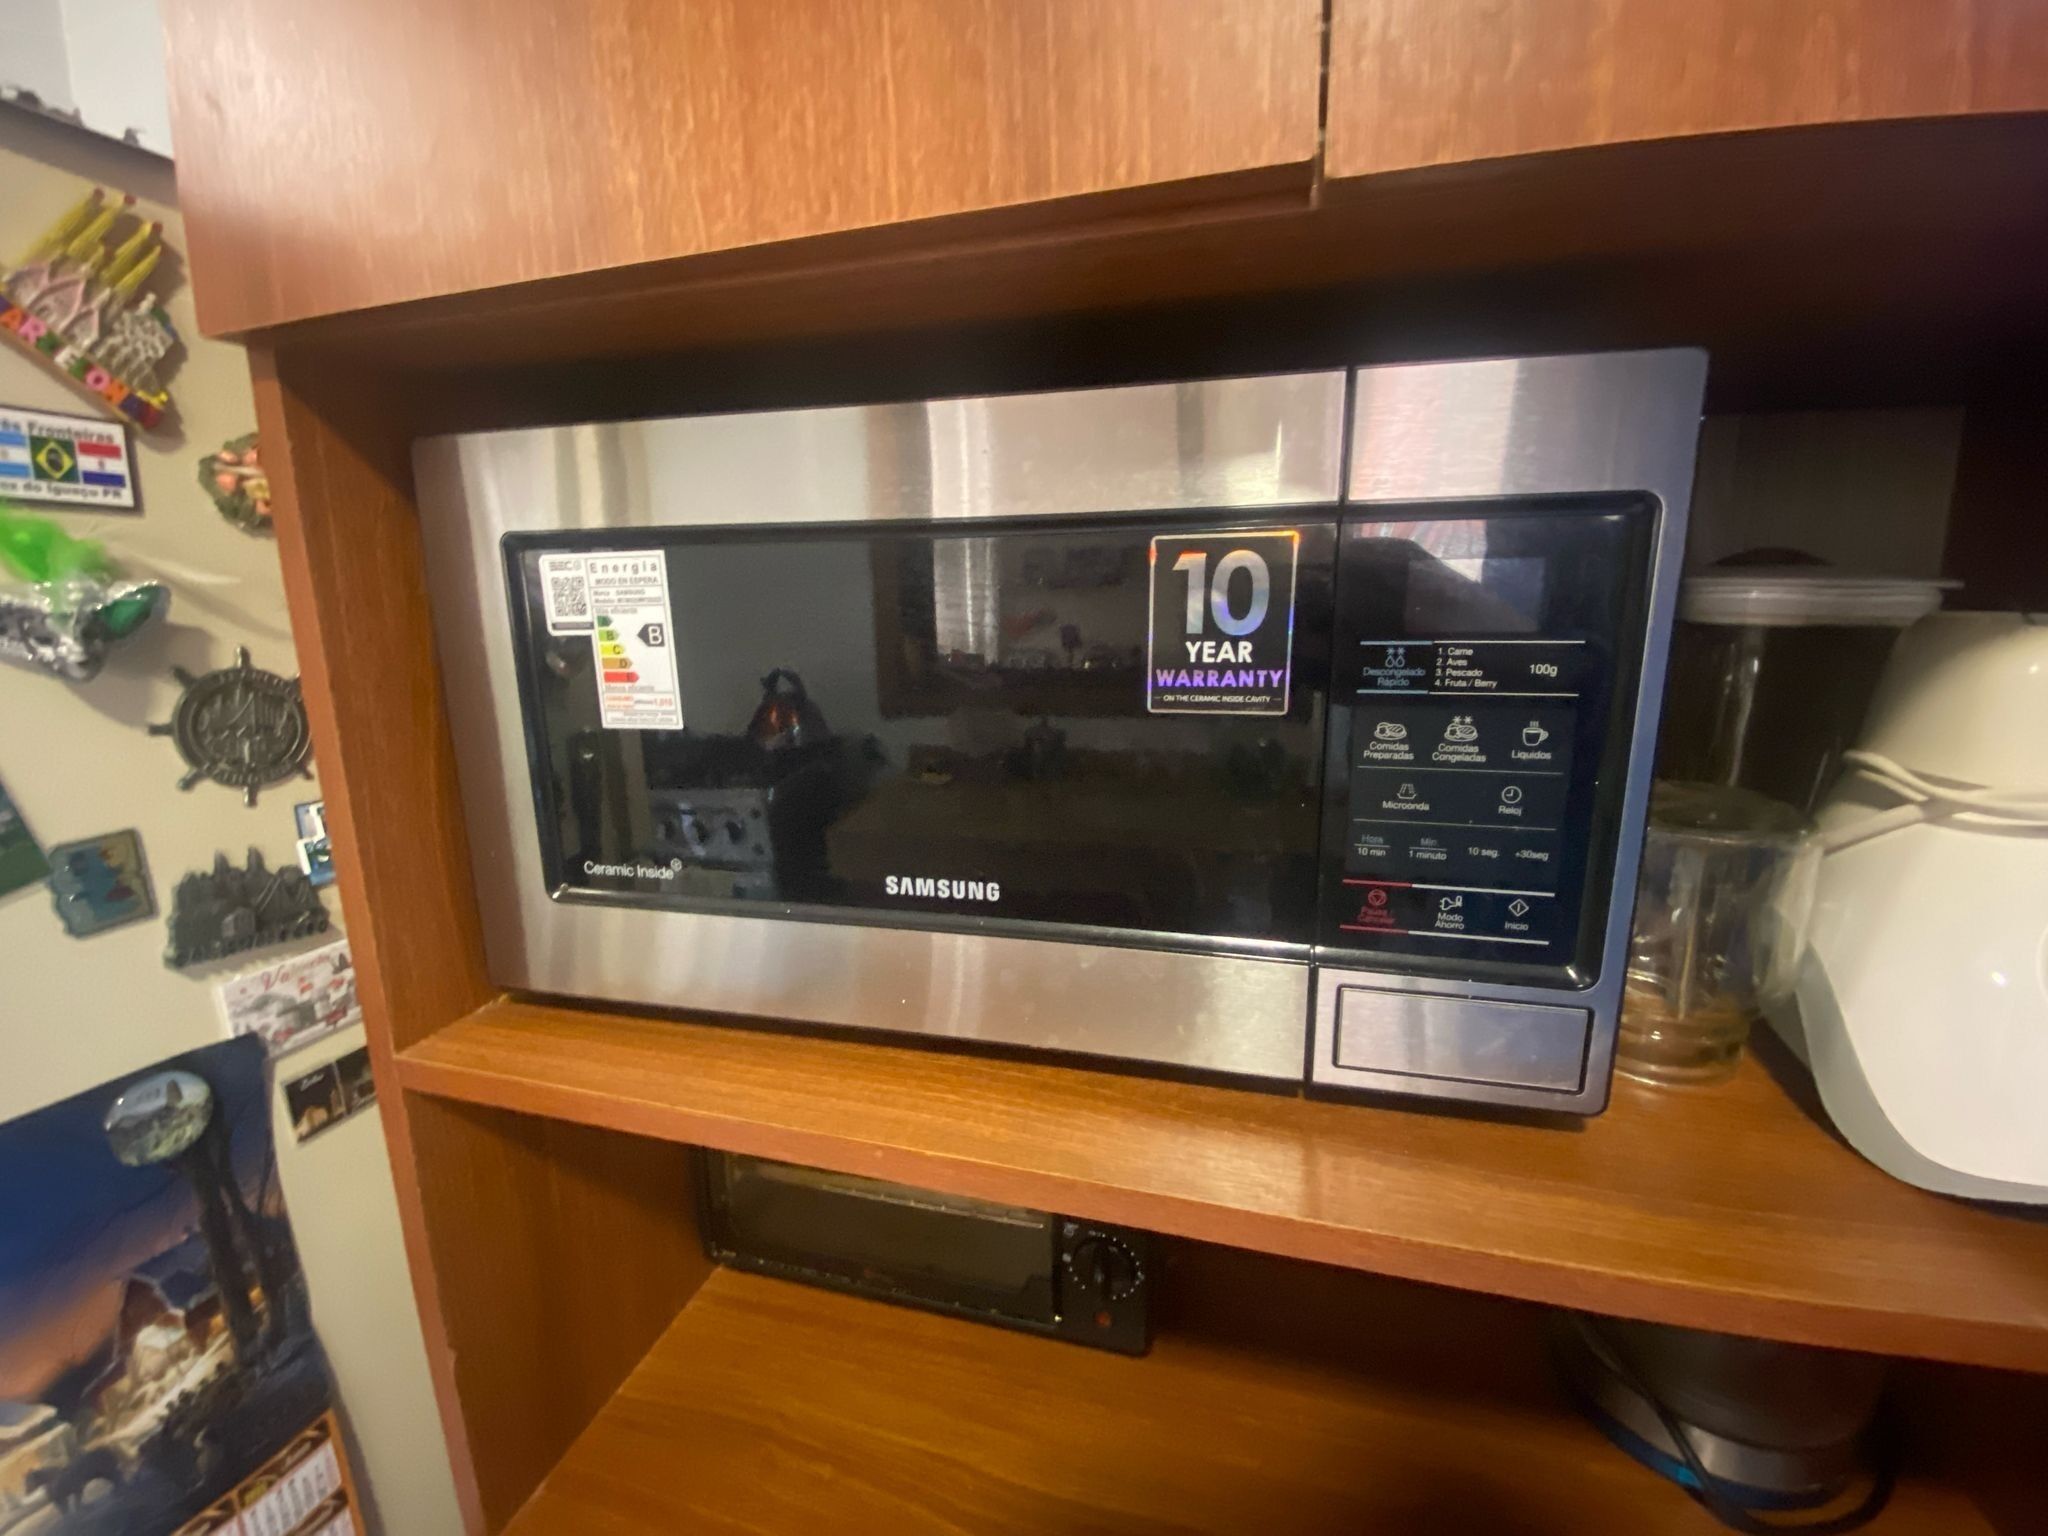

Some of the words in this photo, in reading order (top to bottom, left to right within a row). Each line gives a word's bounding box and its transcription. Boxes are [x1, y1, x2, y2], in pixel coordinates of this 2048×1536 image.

[1172, 550, 1270, 636] 10
[648, 626, 662, 644] B
[1185, 641, 1253, 663] YEAR
[1529, 663, 1558, 677] 100g
[1156, 669, 1283, 688] WARRANTY
[1190, 695, 1221, 703] CERAMIC
[1369, 742, 1409, 751] Comidas
[1438, 743, 1479, 753] Comidas
[1363, 750, 1414, 760] Preparadas
[1382, 800, 1430, 811] Microonda
[1358, 848, 1368, 856] 10
[1468, 847, 1479, 855] 10
[584, 860, 635, 877] Ceramic
[885, 875, 1000, 902] SAMSUNG
[1504, 921, 1529, 931] Inicio
